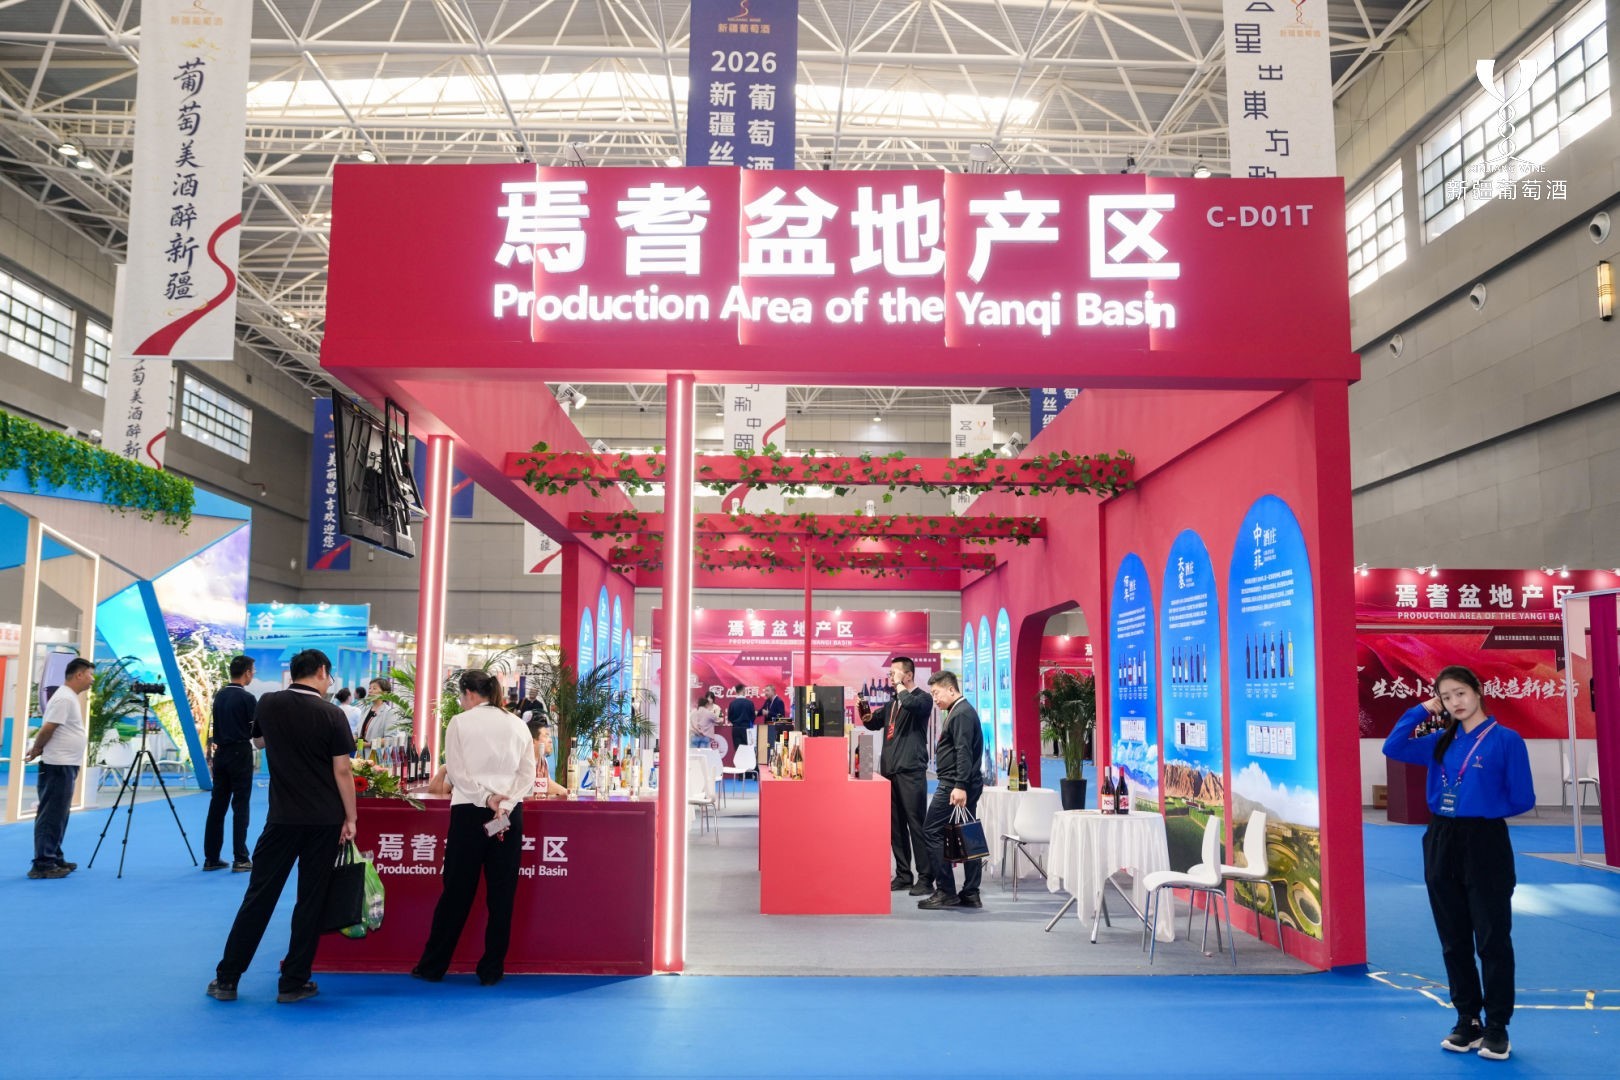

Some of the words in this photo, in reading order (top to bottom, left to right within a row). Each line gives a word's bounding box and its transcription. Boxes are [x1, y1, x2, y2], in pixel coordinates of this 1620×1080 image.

[711, 51, 777, 73] 2026
[163, 57, 206, 300] 葡萄美酒醉新疆
[1207, 204, 1314, 228] C-D01T
[495, 181, 1180, 283] 焉耆盆地产区
[494, 283, 709, 321] Production
[720, 285, 812, 323] Area
[825, 286, 869, 323] of
[879, 286, 945, 323] the
[955, 291, 1061, 336] Yanqi
[1076, 290, 1176, 329] Basin
[123, 359, 146, 459] 萄美酒醉新
[1395, 584, 1575, 608] 焉耆盆地产区
[248, 611, 276, 632] 谷
[1398, 611, 1456, 620] PRODUCTION
[1459, 611, 1483, 620] AREA
[1485, 612, 1497, 620] OF
[1500, 612, 1517, 620] THE
[1371, 676, 1440, 700] 生态小
[376, 863, 437, 875] Production
[538, 865, 568, 876] Basin
